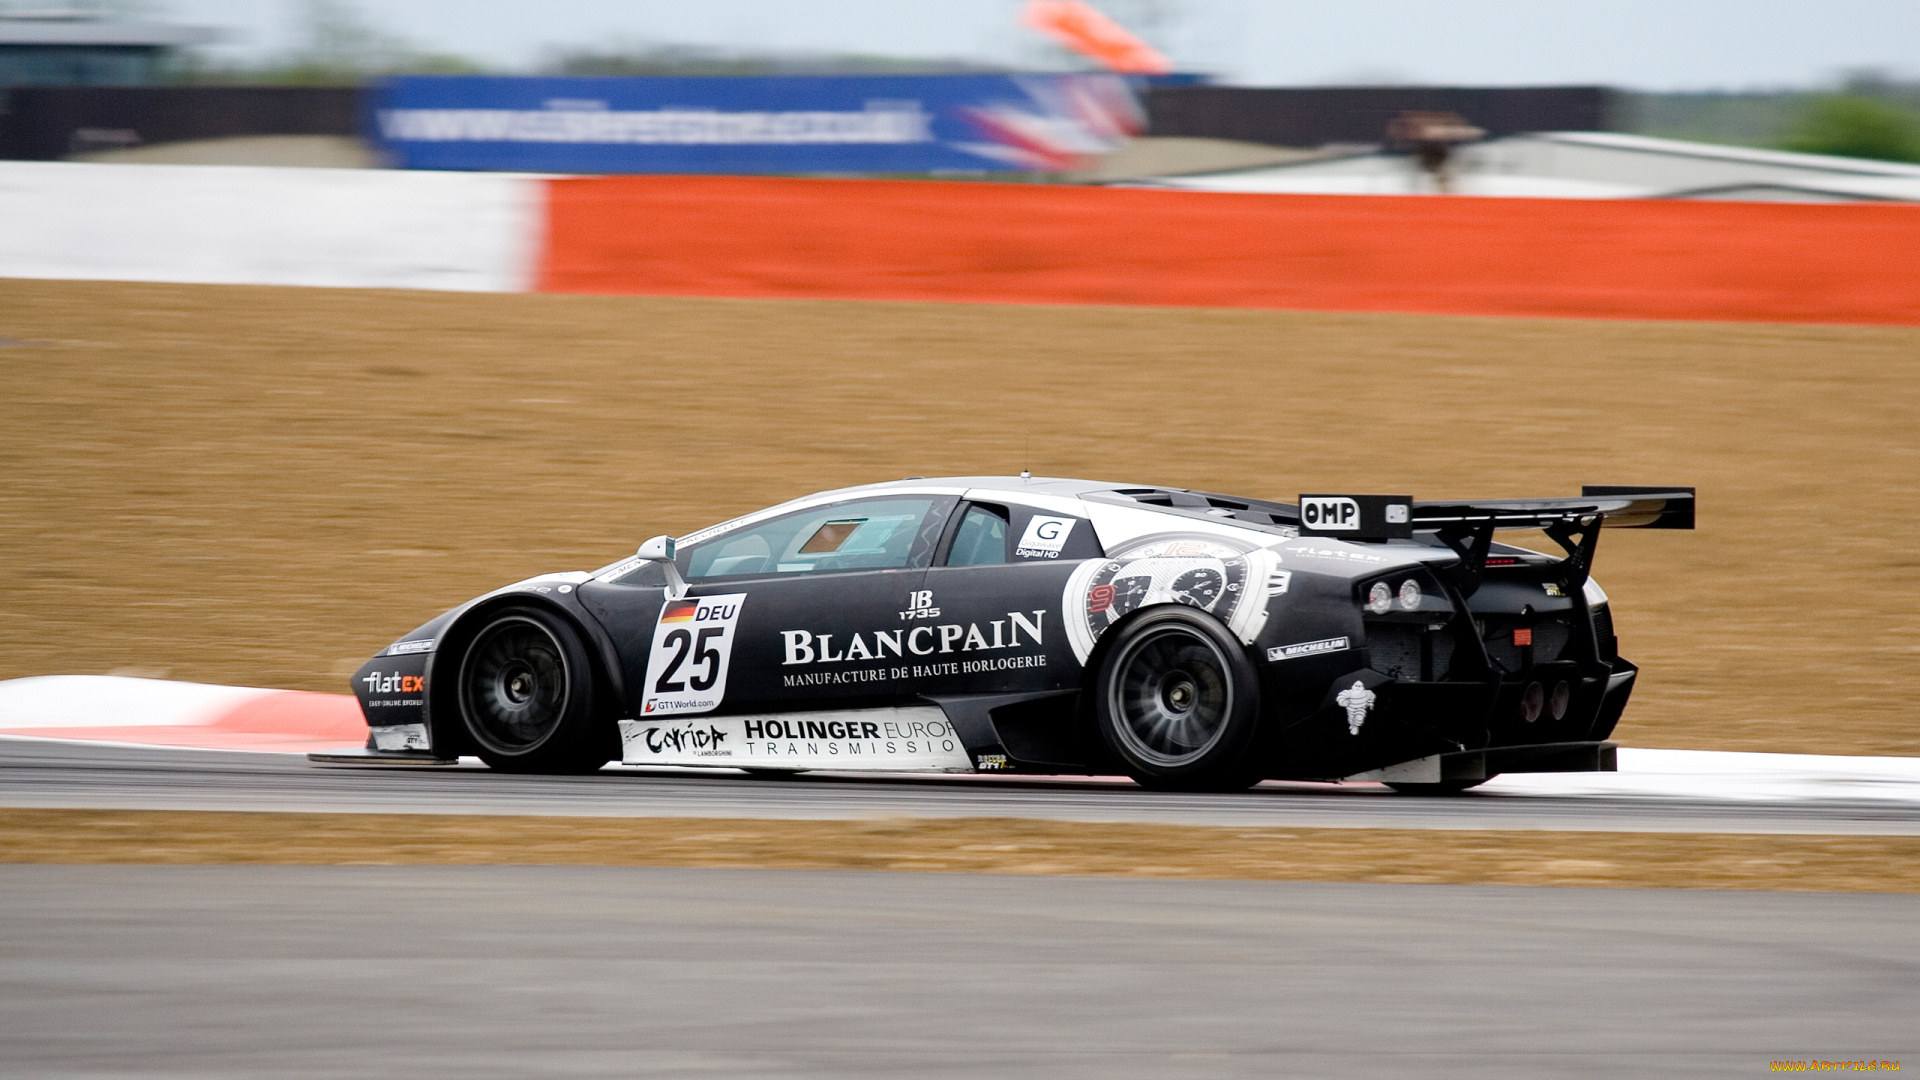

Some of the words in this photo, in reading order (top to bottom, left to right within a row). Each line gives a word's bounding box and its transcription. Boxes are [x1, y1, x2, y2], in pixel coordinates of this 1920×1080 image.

[1305, 503, 1356, 525] OMP
[1036, 521, 1063, 540] G
[1016, 548, 1044, 558] Digital
[1044, 551, 1059, 559] HD
[695, 604, 737, 622] DEU
[899, 607, 941, 621] 1735
[780, 609, 1047, 665] BLANCPAIN
[1285, 639, 1345, 655] MICHELIN
[655, 627, 725, 693] 25
[783, 668, 887, 688] MANUFACTURE
[891, 667, 909, 680] DE
[913, 662, 959, 677] HAUTE
[963, 655, 1047, 674] HORLOGERIE
[744, 720, 881, 739] HOLINGER
[746, 739, 954, 755] TRANSMISSIO
